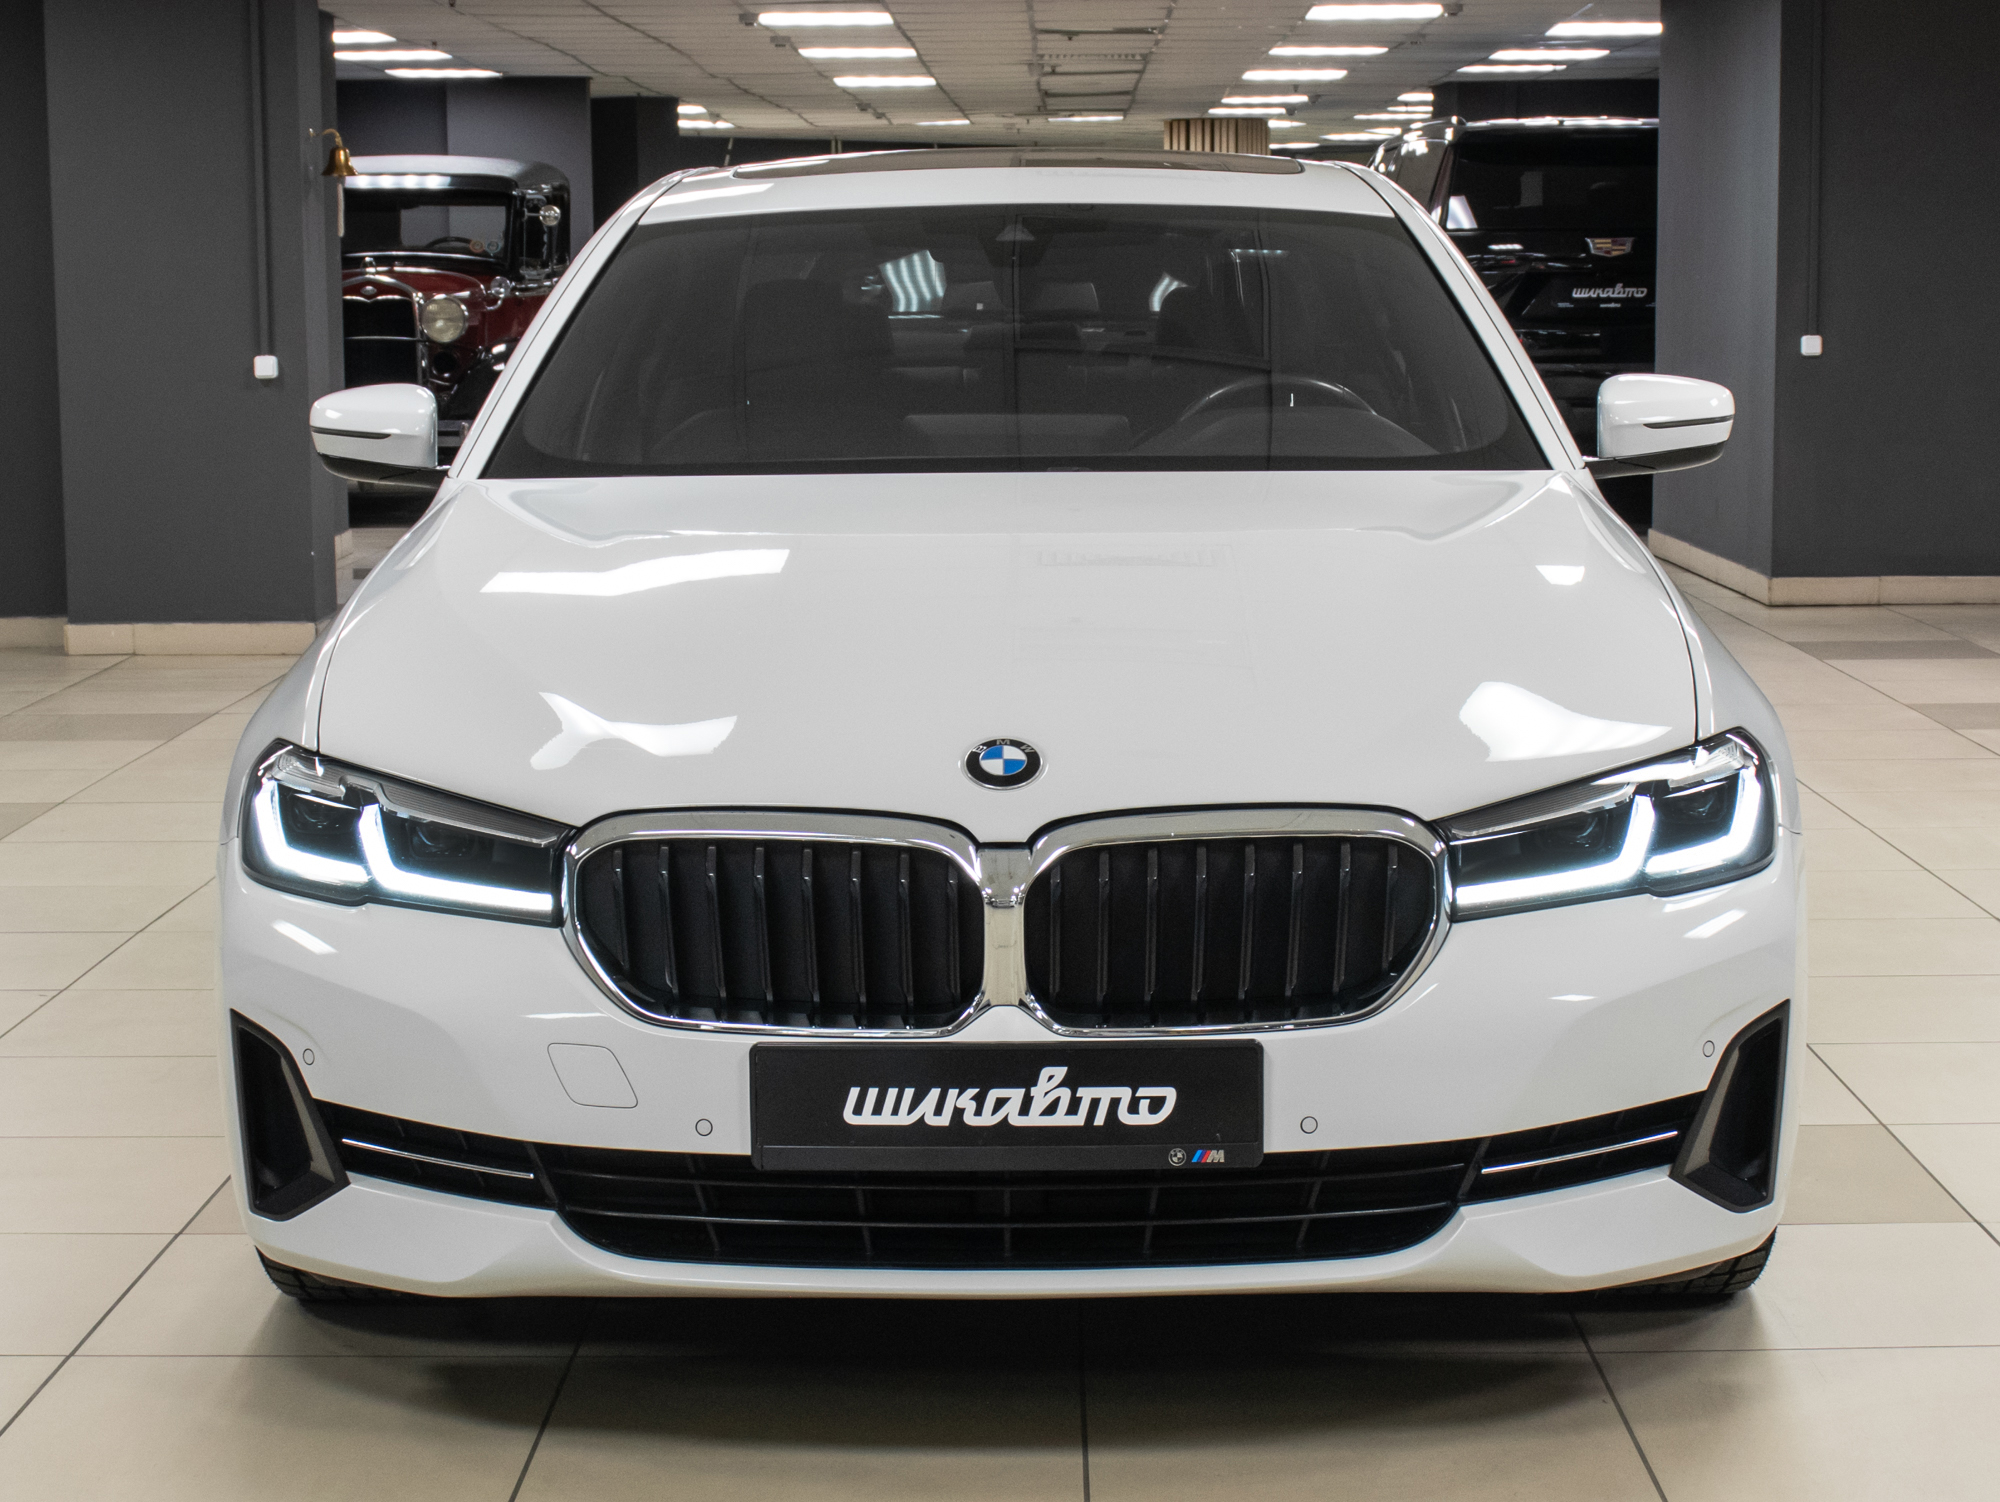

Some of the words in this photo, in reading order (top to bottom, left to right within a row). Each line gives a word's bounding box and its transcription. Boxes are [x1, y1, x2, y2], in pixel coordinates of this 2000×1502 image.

[1572, 283, 1648, 298] шикавто
[972, 739, 1036, 753] BMW
[842, 1066, 1177, 1127] шикавто
